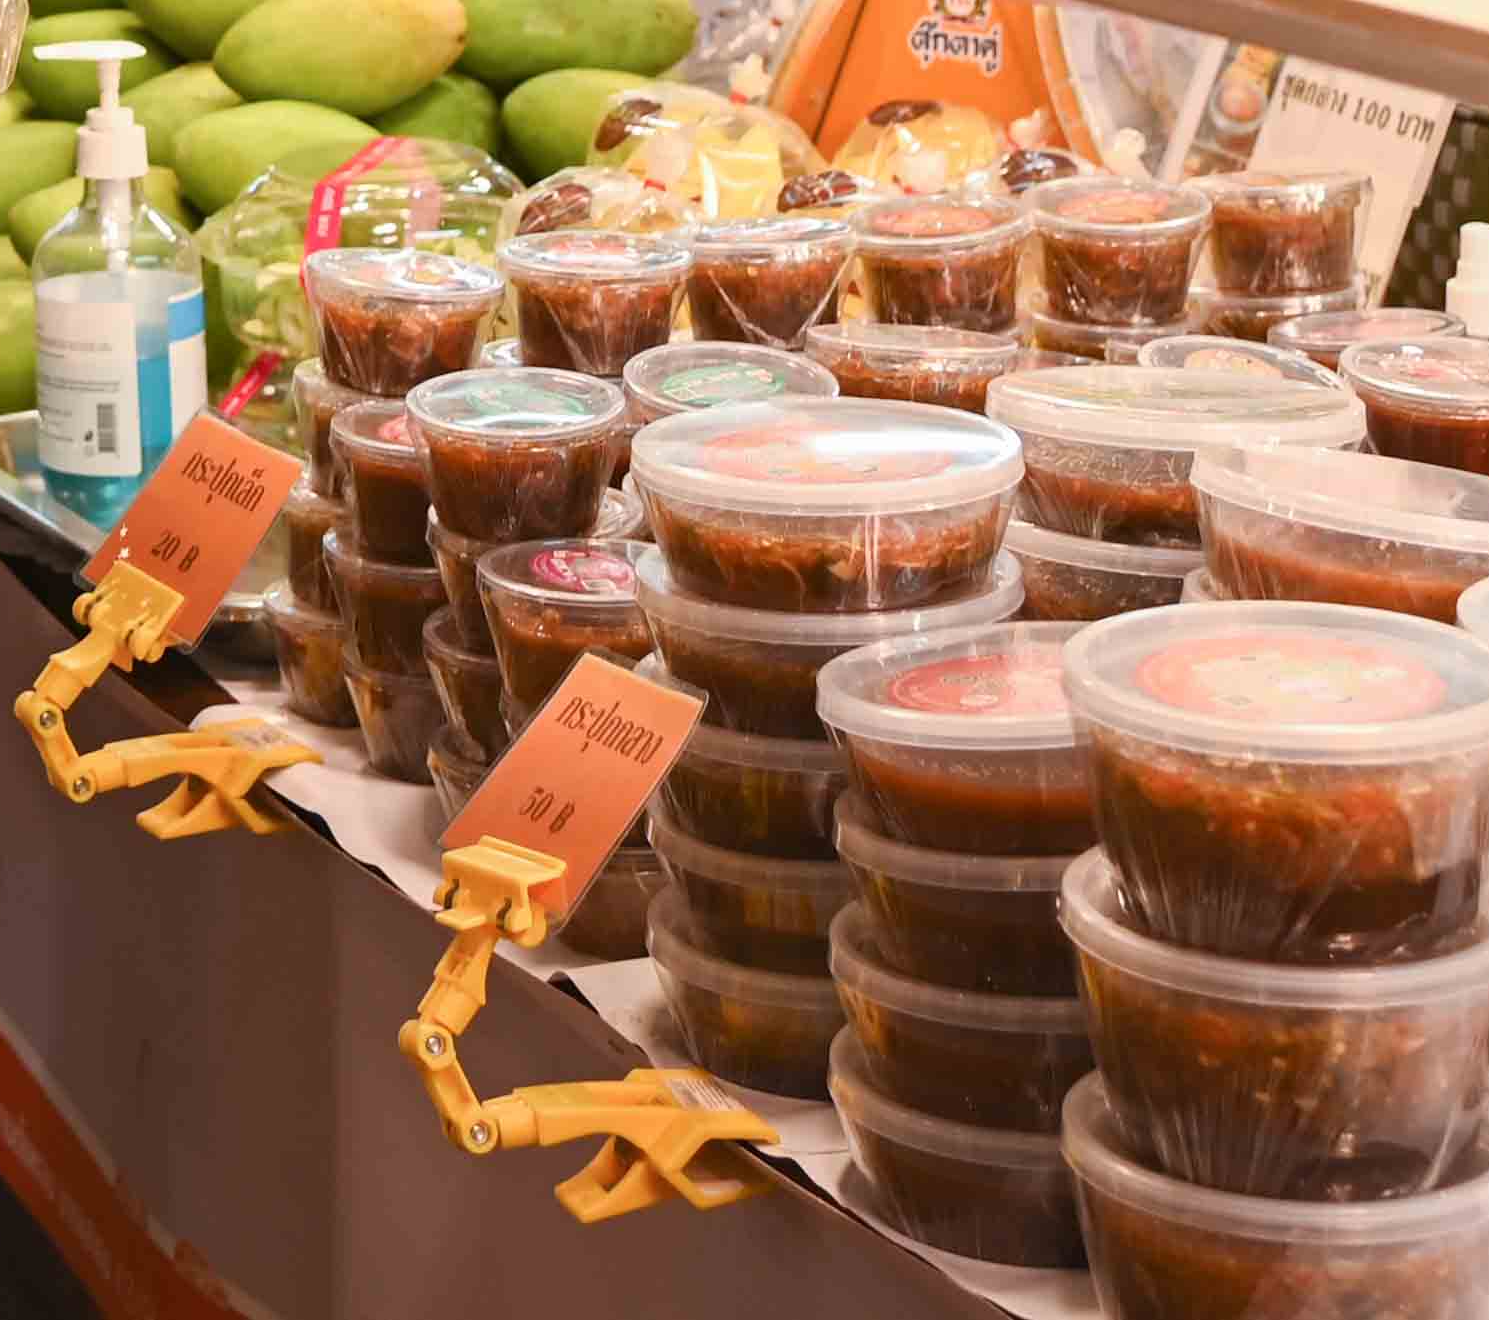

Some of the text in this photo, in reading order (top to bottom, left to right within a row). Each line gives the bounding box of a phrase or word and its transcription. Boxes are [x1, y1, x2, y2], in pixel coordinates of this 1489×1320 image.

[1353, 96, 1393, 130] 100
[1396, 110, 1436, 144] บาท
[151, 530, 181, 561] 20
[556, 695, 665, 767] กระปุกกลาง
[519, 786, 555, 823] 50
